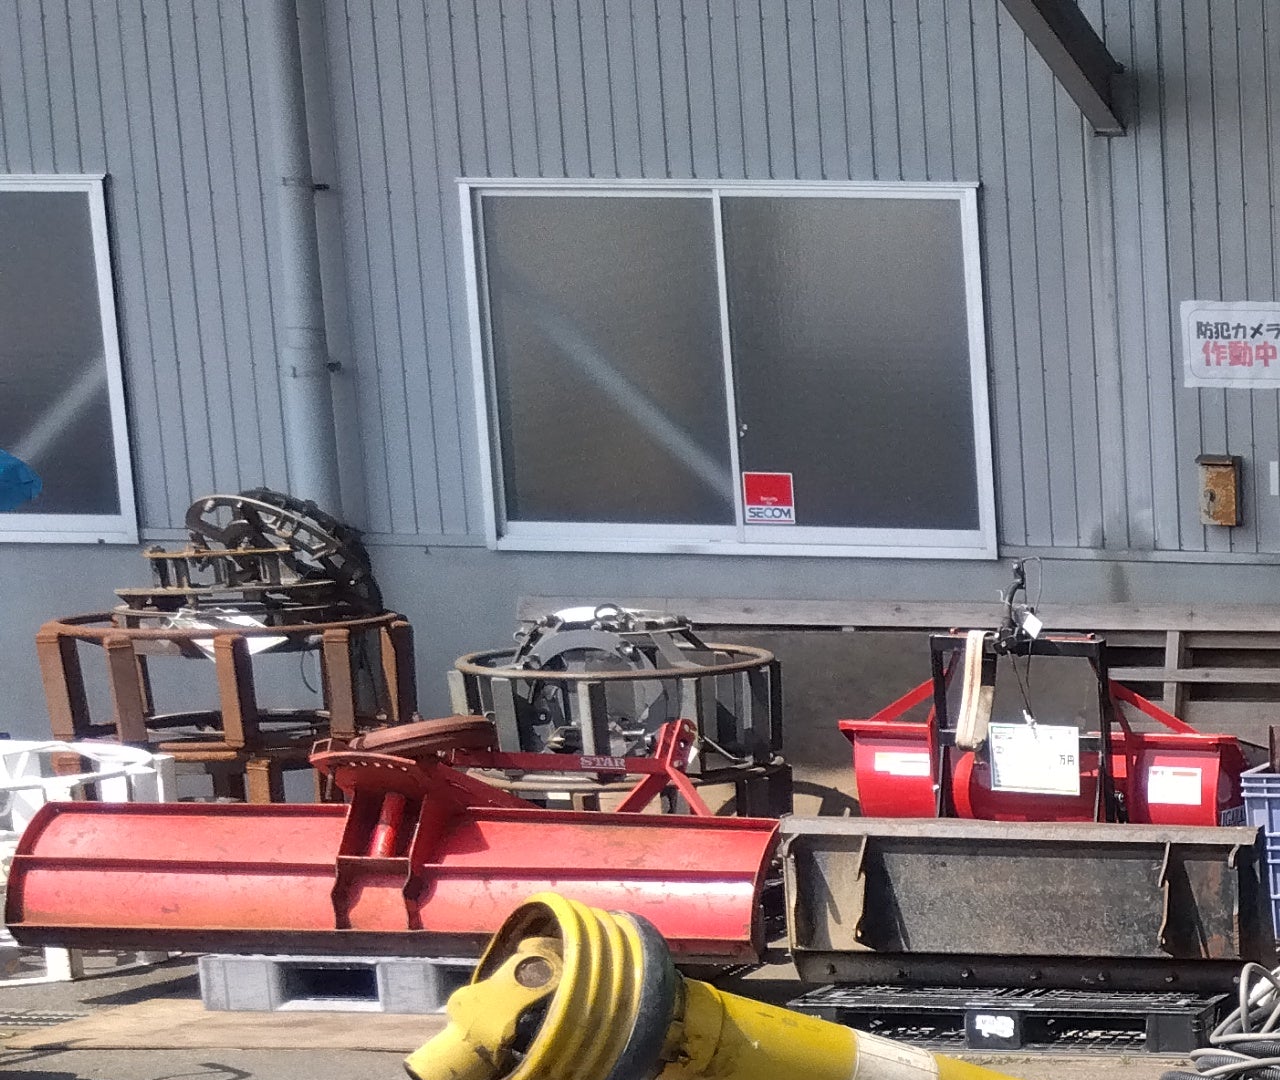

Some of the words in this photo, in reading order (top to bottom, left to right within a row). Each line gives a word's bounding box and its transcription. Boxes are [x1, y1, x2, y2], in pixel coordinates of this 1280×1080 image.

[1196, 321, 1280, 339] 防犯カメラ
[1202, 341, 1277, 367] 作動中
[748, 507, 792, 518] SECOM
[580, 756, 626, 768] STAR
[1059, 754, 1075, 766] 万円
